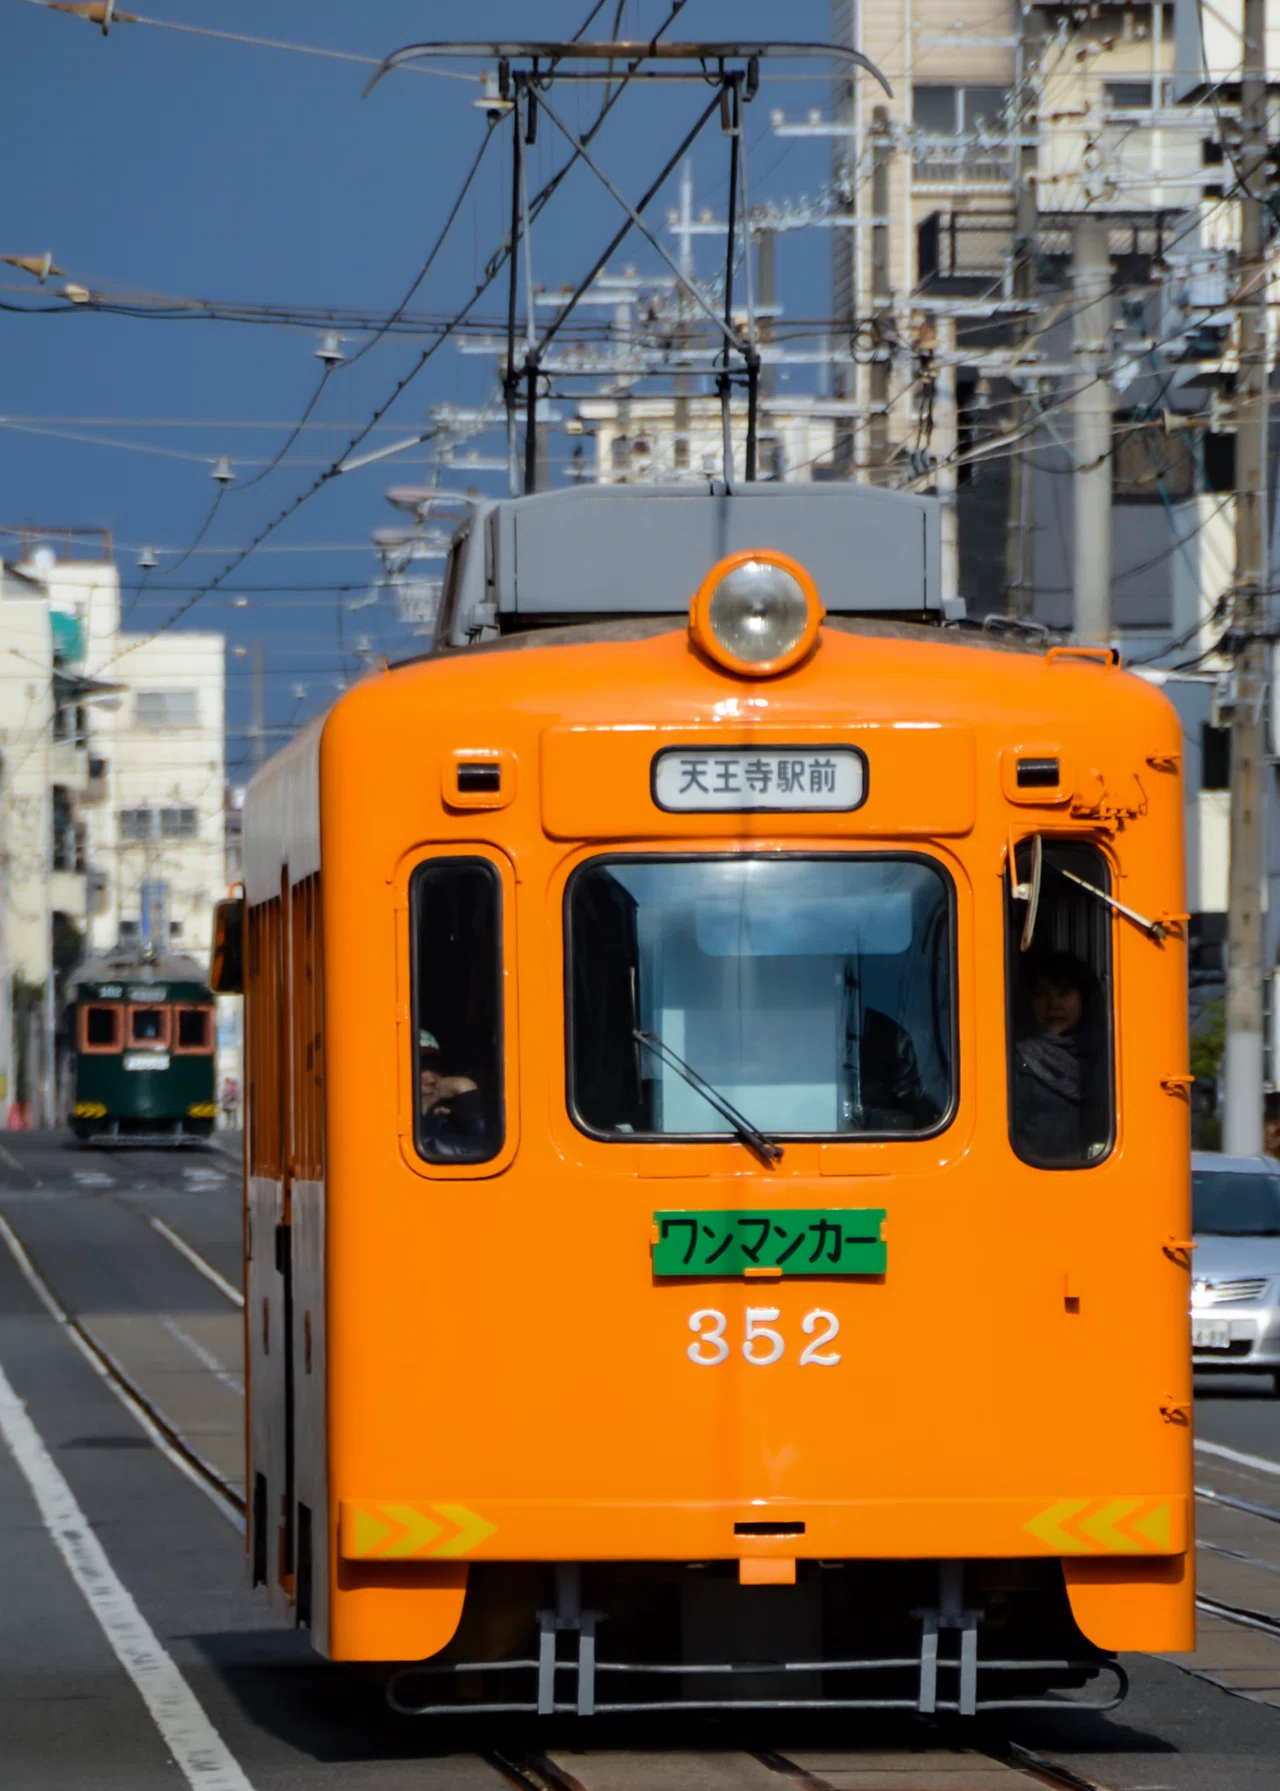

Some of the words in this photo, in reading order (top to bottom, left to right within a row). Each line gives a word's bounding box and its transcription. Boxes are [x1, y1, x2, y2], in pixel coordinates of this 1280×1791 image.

[679, 758, 837, 794] 天王寺駅前
[661, 1218, 878, 1265] ワンマンカー
[687, 1307, 842, 1367] 352
